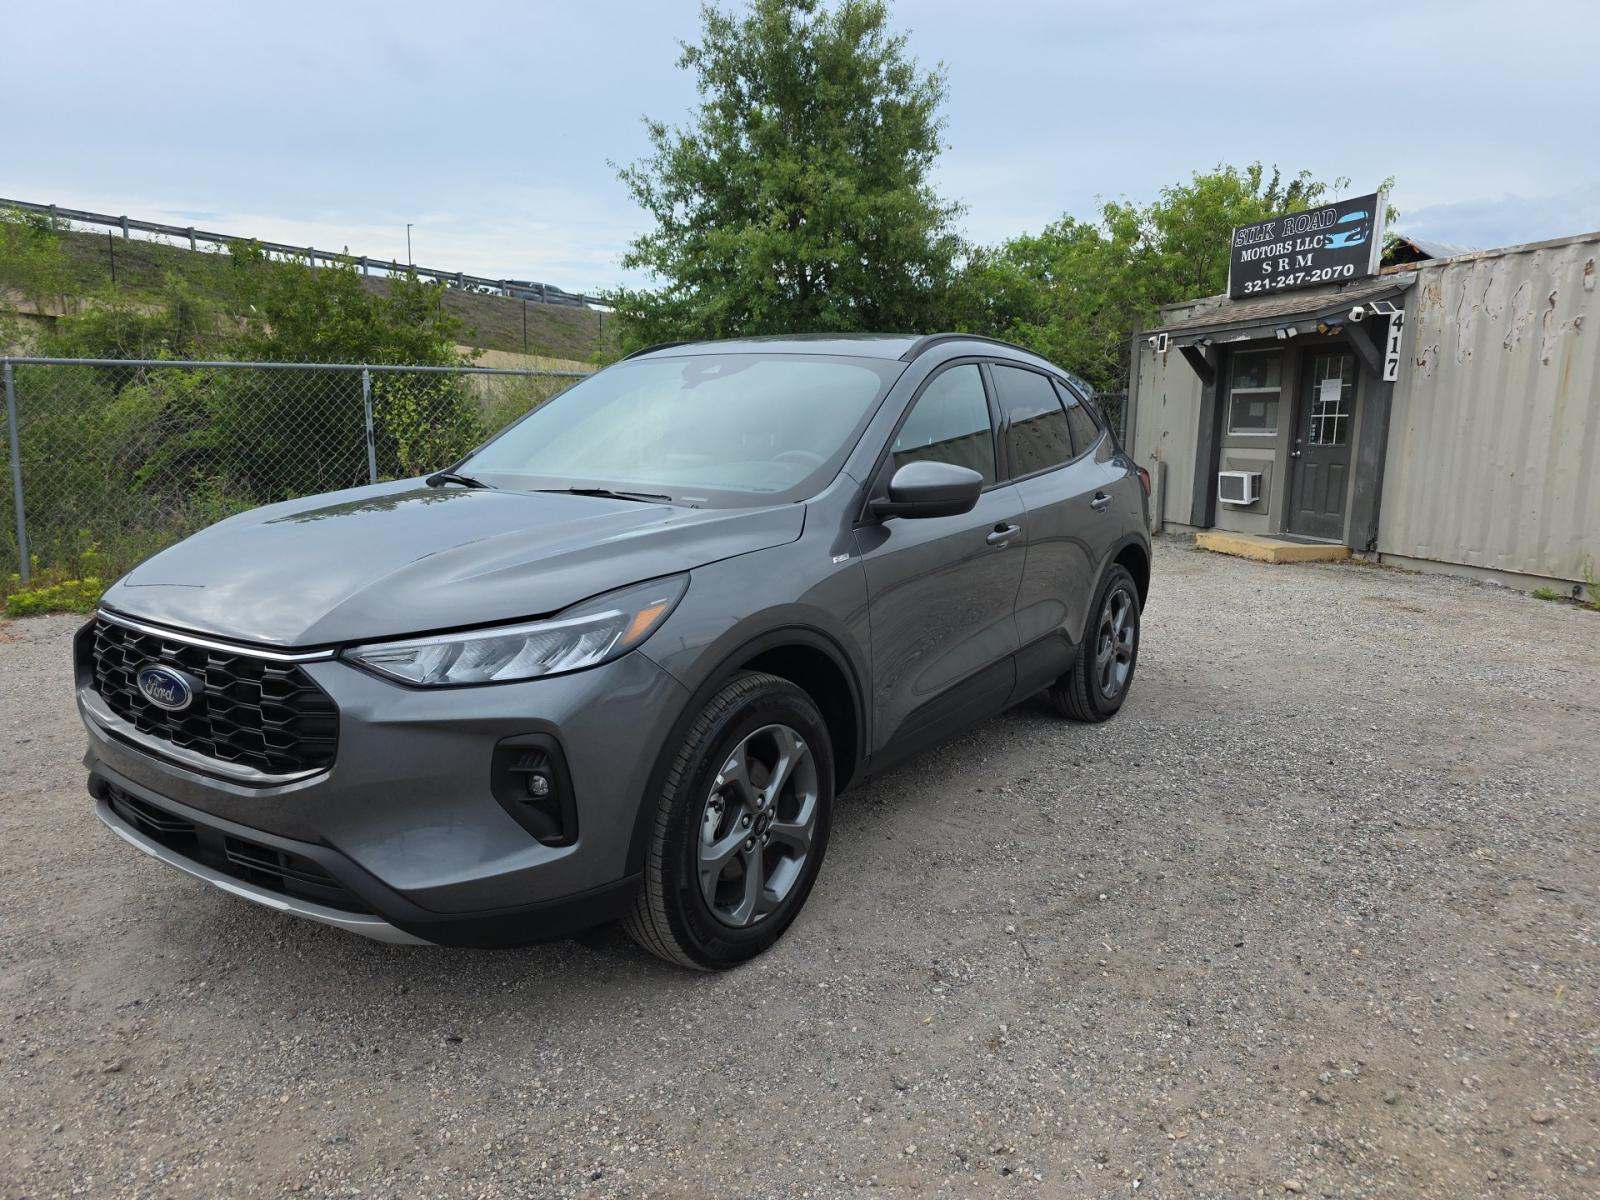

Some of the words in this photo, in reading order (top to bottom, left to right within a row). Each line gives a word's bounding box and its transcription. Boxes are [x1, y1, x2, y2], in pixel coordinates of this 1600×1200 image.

[1235, 222, 1276, 247] SILK
[1282, 208, 1338, 237] ROAD
[1240, 241, 1292, 262] MOTORS
[1295, 235, 1324, 252] LLC
[1244, 264, 1354, 293] 321-247-2070
[1388, 313, 1403, 376] 417
[145, 673, 175, 701] Ford
